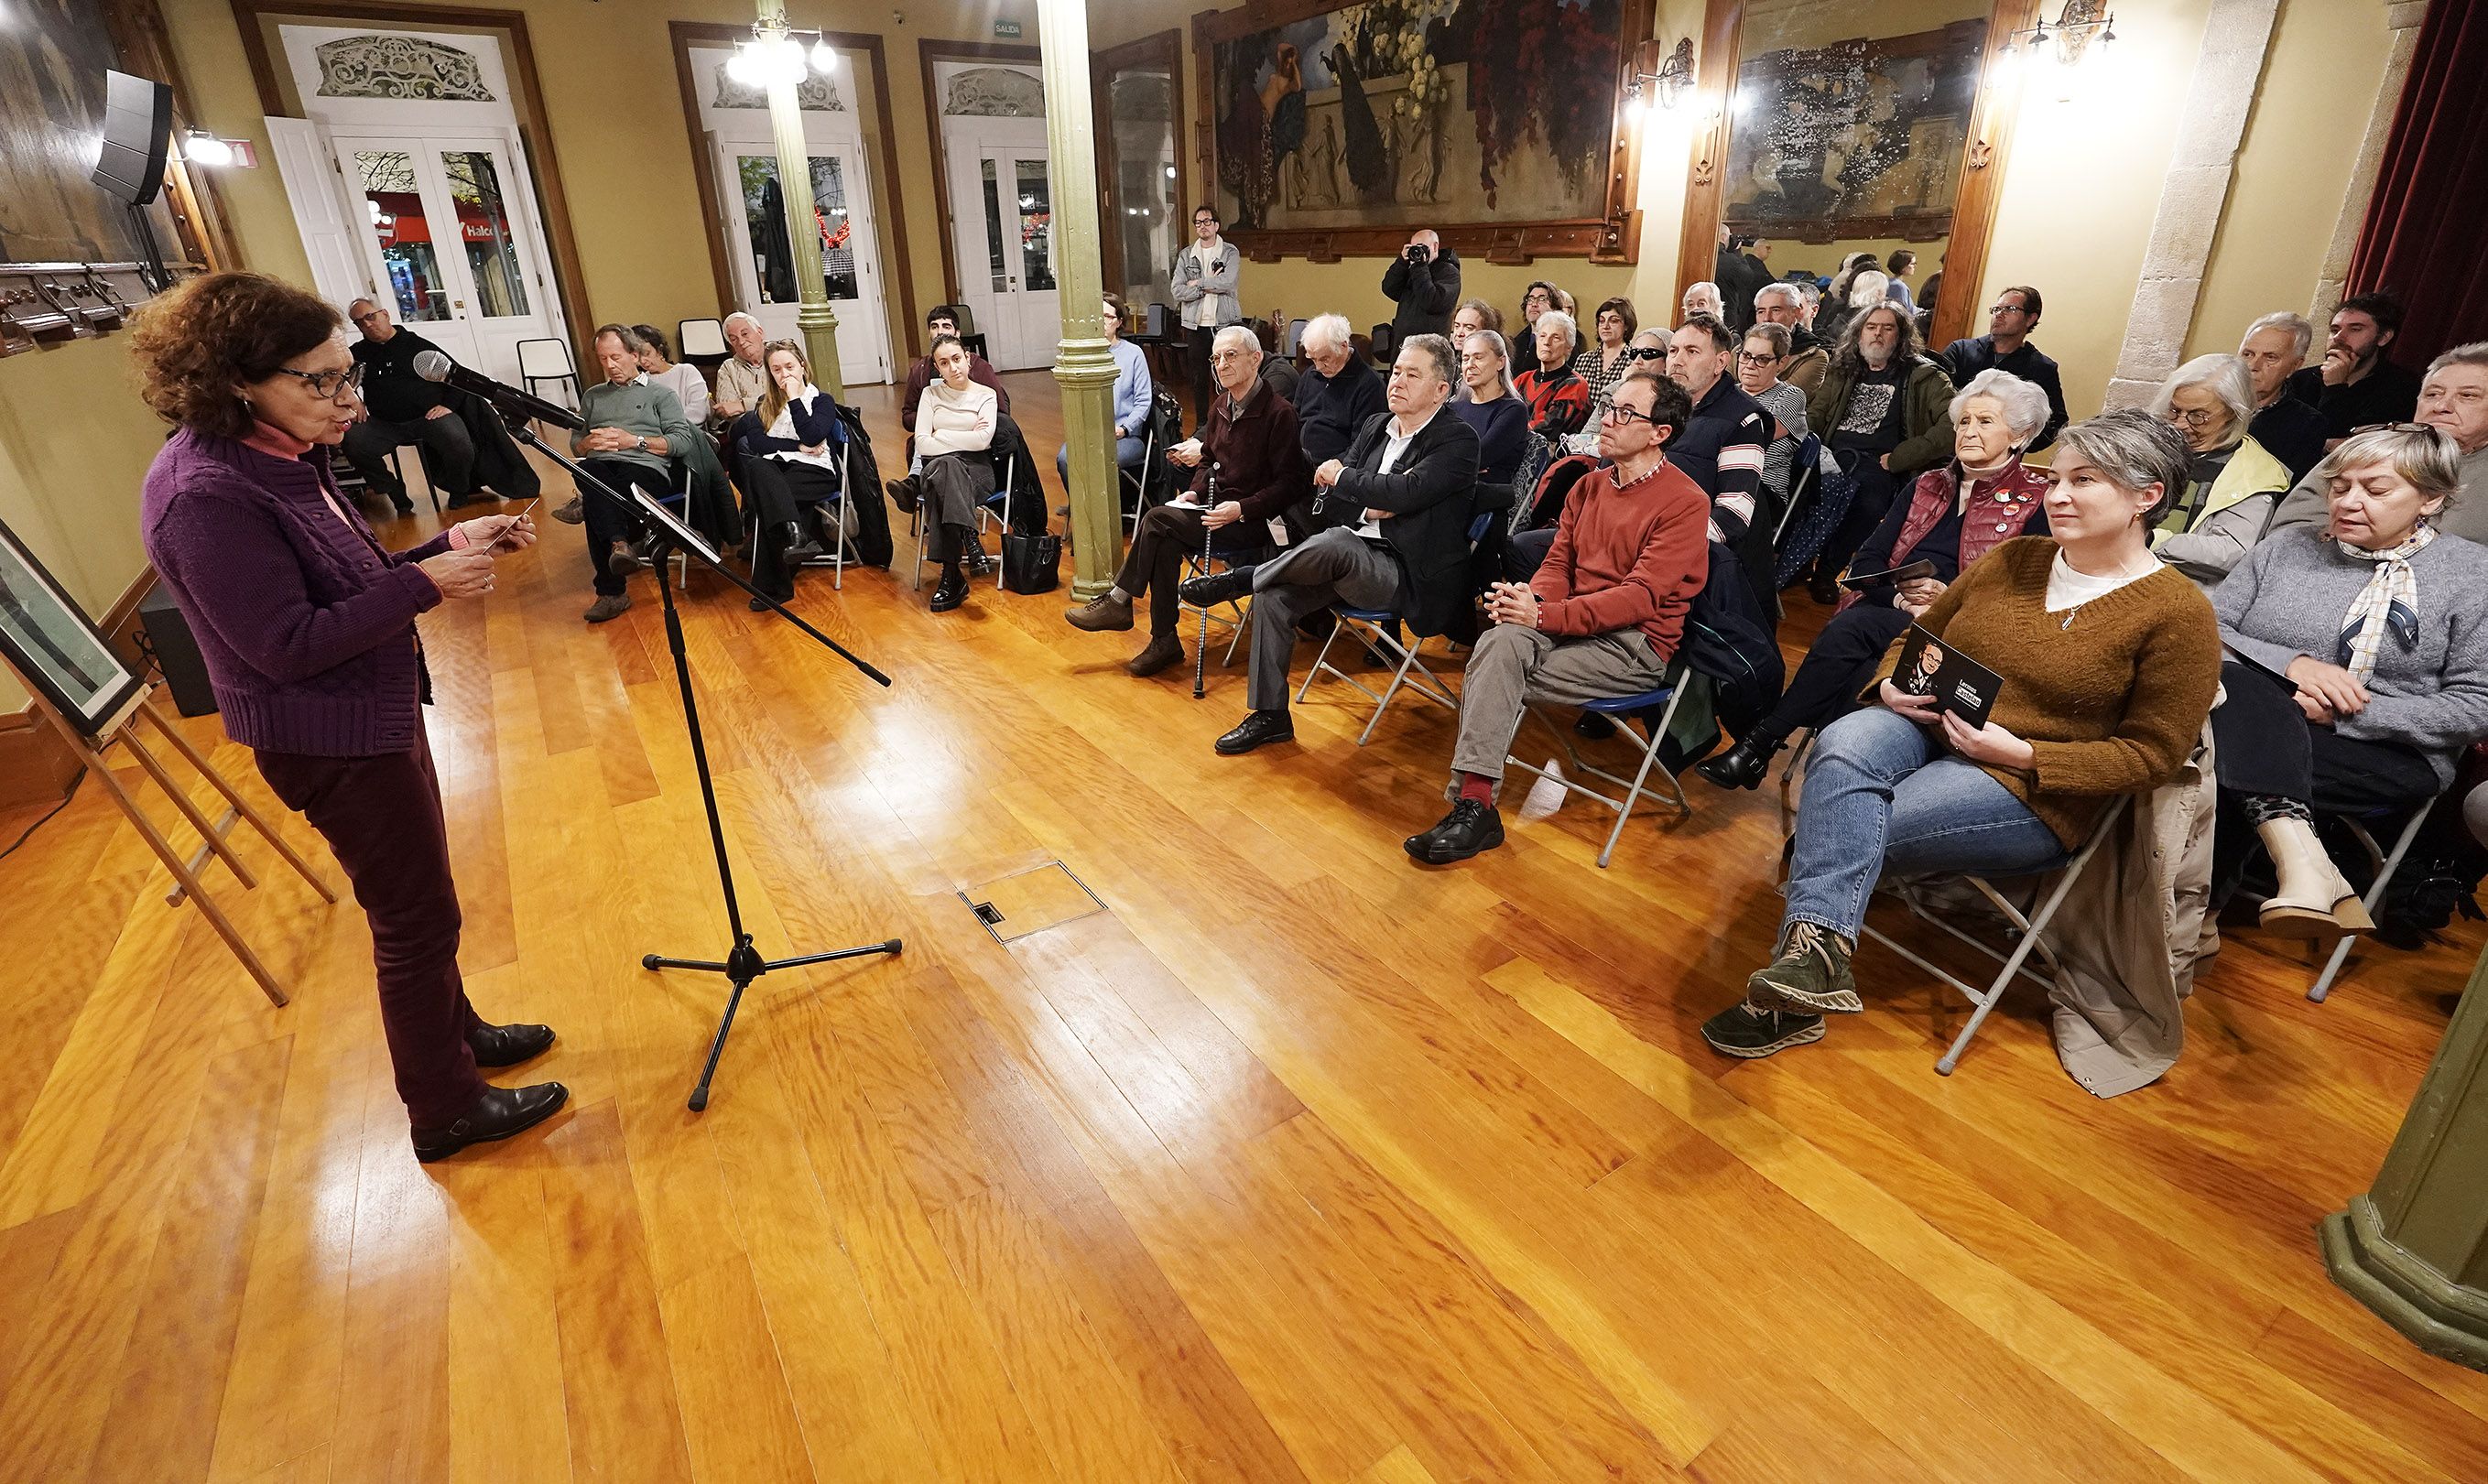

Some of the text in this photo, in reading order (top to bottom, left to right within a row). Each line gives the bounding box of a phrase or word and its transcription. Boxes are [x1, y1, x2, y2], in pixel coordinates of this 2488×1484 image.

[996, 24, 1019, 34] SALIDA
[466, 224, 494, 236] Halc
[1956, 686, 1981, 706] Castelao
